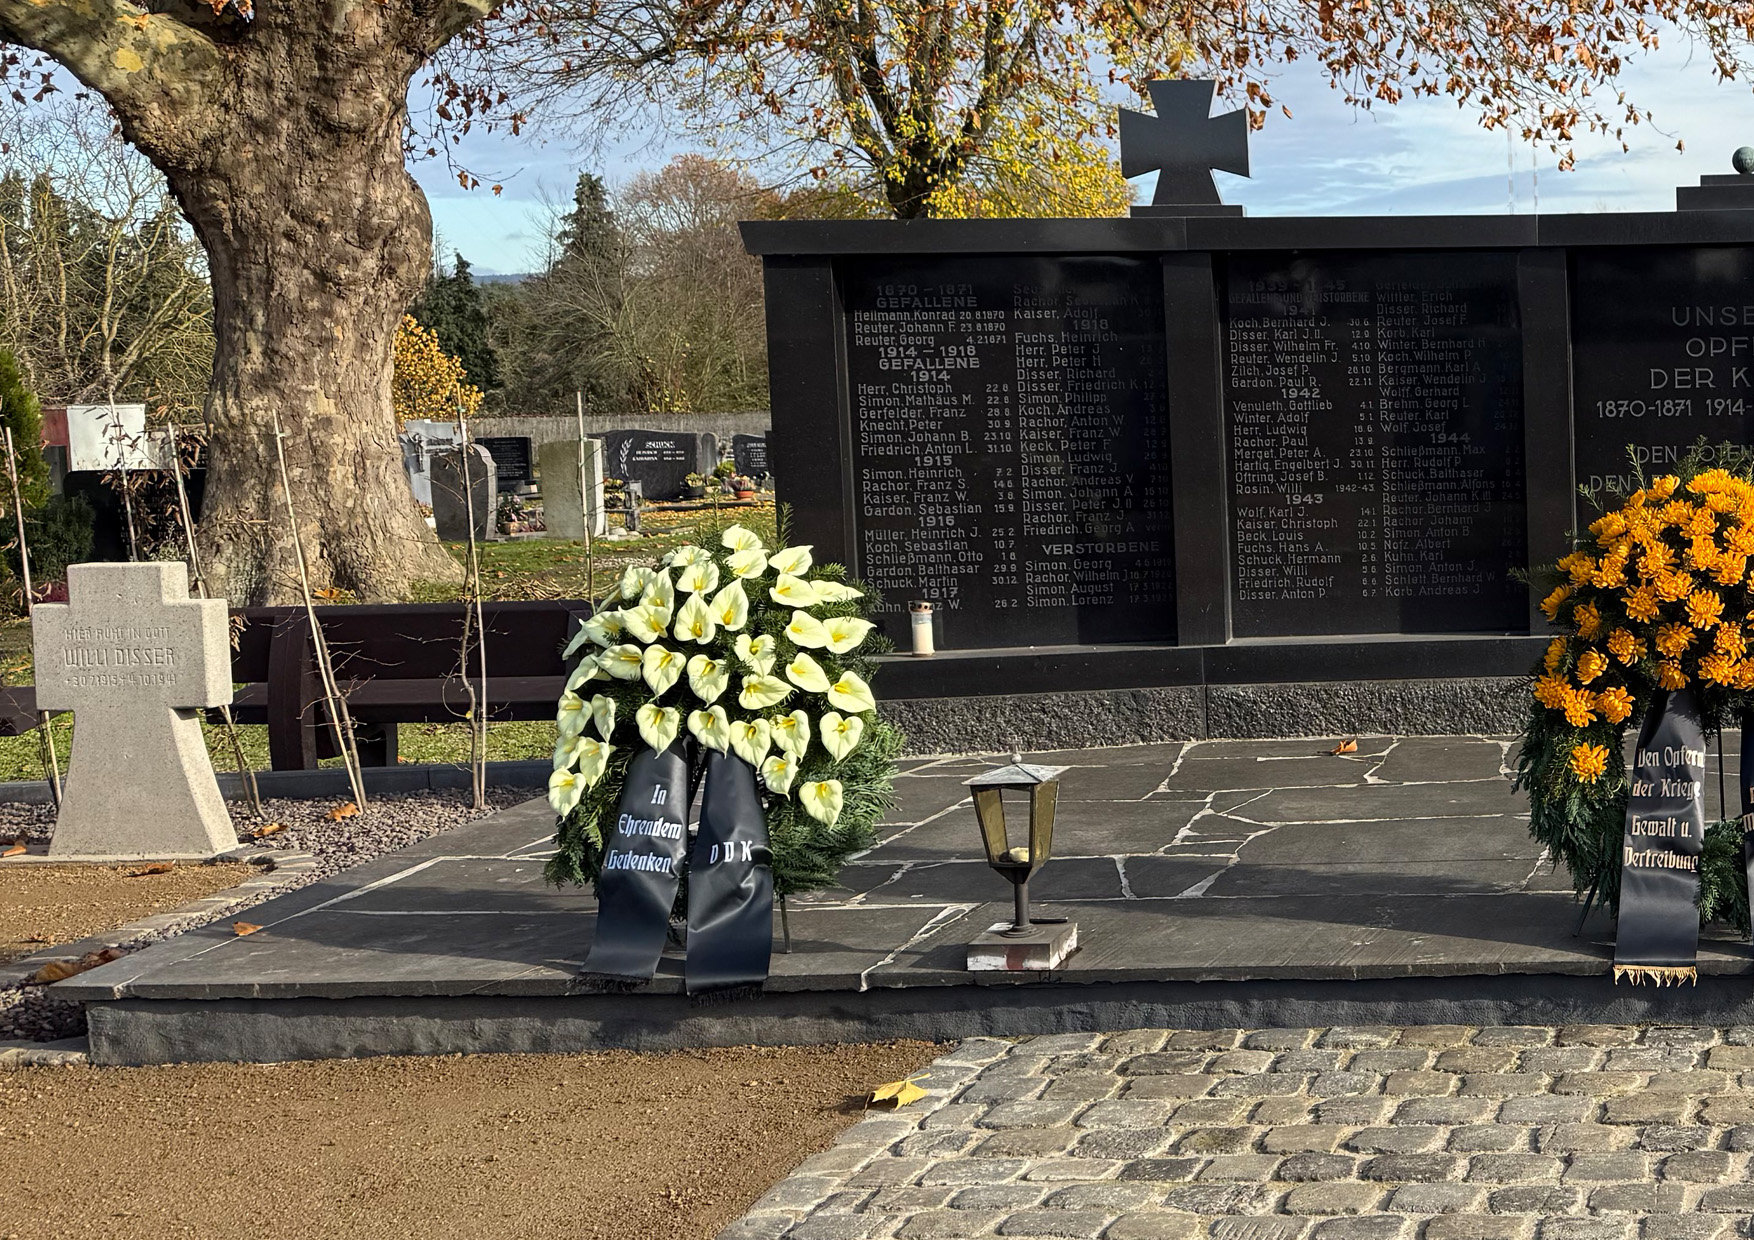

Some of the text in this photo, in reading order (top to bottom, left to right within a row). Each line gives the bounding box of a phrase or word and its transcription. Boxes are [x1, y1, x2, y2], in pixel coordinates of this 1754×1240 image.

[876, 297, 977, 308] GEFALLENE
[879, 346, 976, 357] 1914 1918
[879, 358, 980, 370] GEFALLENE
[1651, 368, 1716, 389] DER
[892, 383, 952, 394] Christoph
[1281, 388, 1321, 398] 1942
[1597, 399, 1692, 417] 1870-1871
[1278, 412, 1309, 423] Adolf
[915, 456, 952, 467] 1915
[1637, 446, 1677, 463] DEN
[1590, 475, 1631, 492] DEN
[1285, 494, 1323, 504] 1943
[1042, 541, 1159, 555] VERSTORBENE
[65, 627, 170, 640] HIER RUHT IN GOTT
[64, 648, 174, 666] WILLI DISSER
[1638, 746, 1704, 768] Den Opfern
[651, 784, 667, 805] In
[1632, 778, 1701, 800] der Kriege
[618, 814, 682, 839] Ehrendem
[1632, 815, 1692, 838] Gewalt u.
[607, 850, 672, 873] Gedenken
[1624, 847, 1698, 872] Vertreibung
